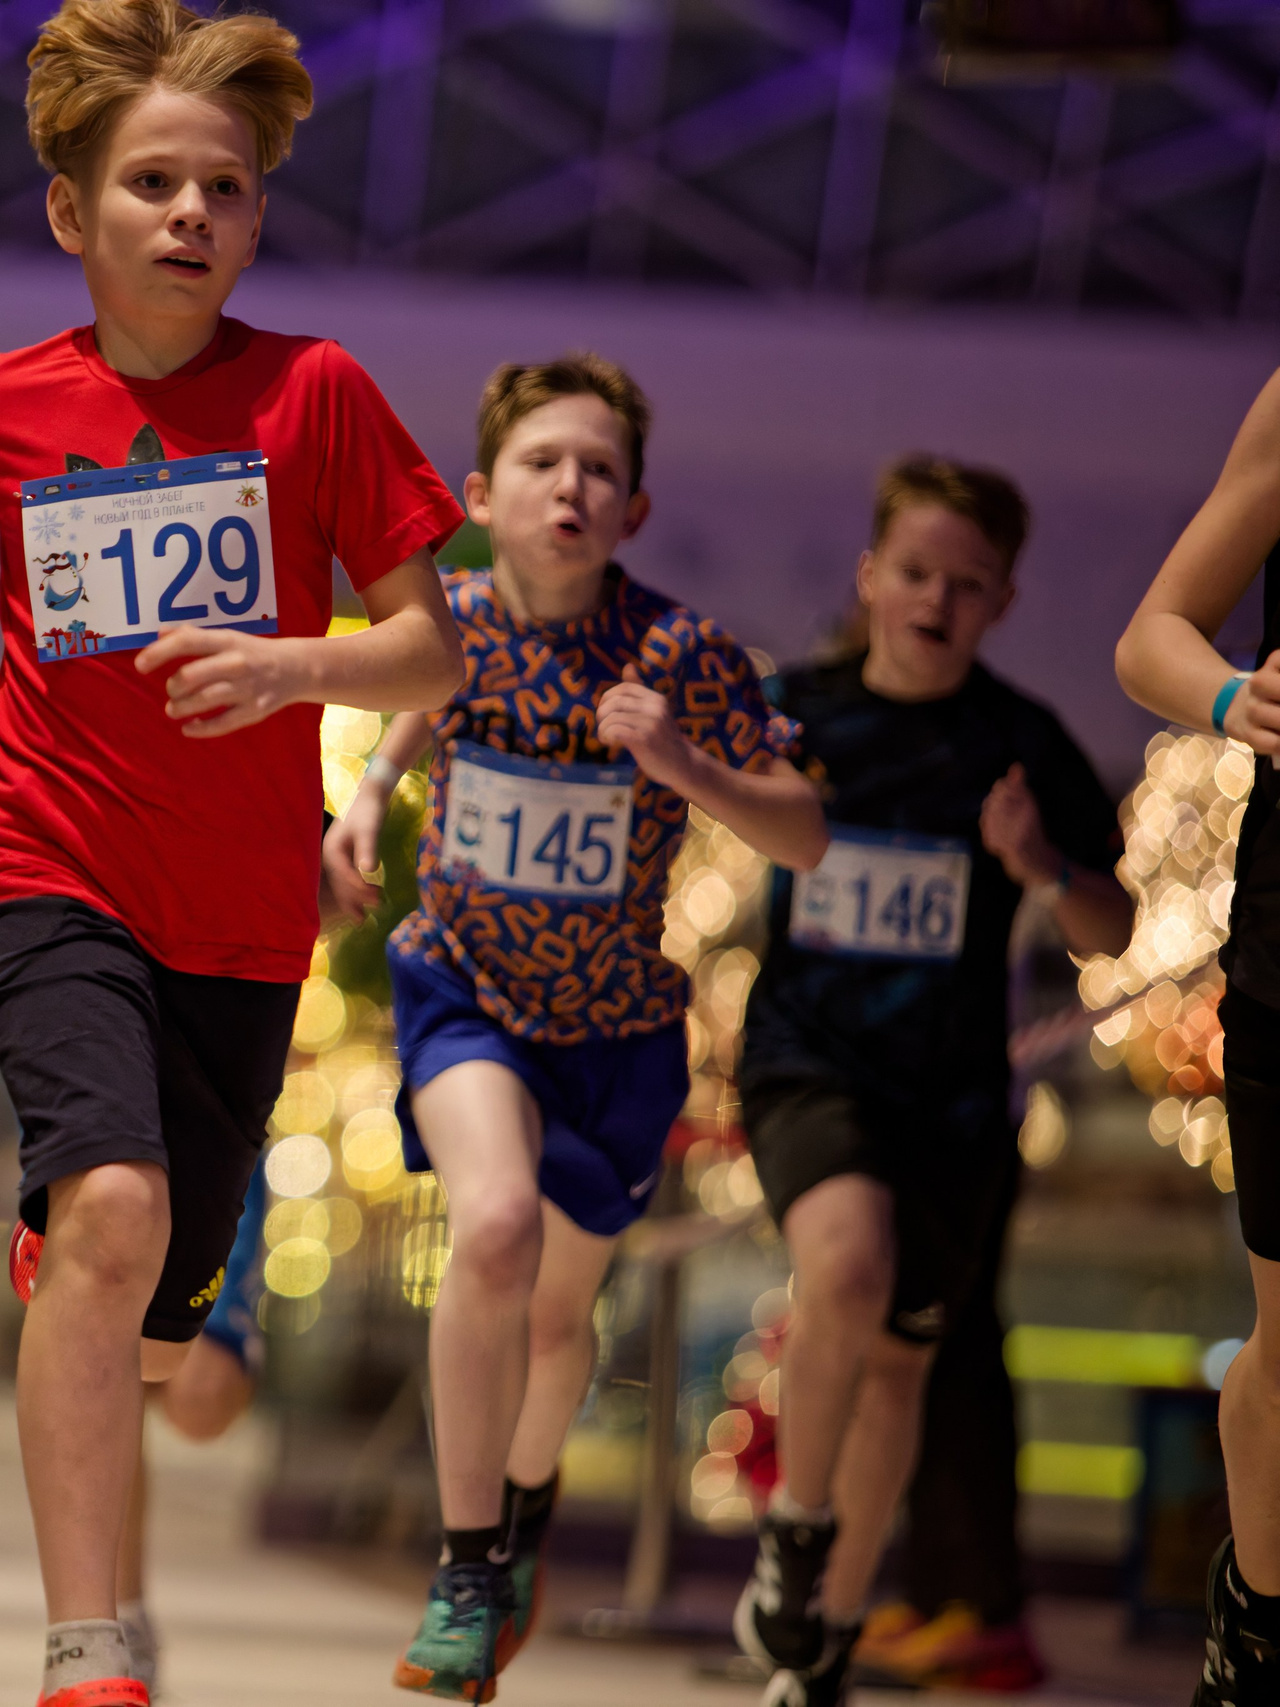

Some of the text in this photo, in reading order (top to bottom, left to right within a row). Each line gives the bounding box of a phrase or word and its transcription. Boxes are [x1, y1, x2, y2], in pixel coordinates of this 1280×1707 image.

[112, 490, 183, 508] НОЧНОЙ ЗАБЕГ
[132, 507, 152, 520] ГОД
[153, 507, 160, 518] В
[162, 501, 205, 516] ПЛАНЕТЕ
[101, 515, 260, 625] 129
[498, 804, 614, 886] 145
[845, 870, 956, 943] 146
